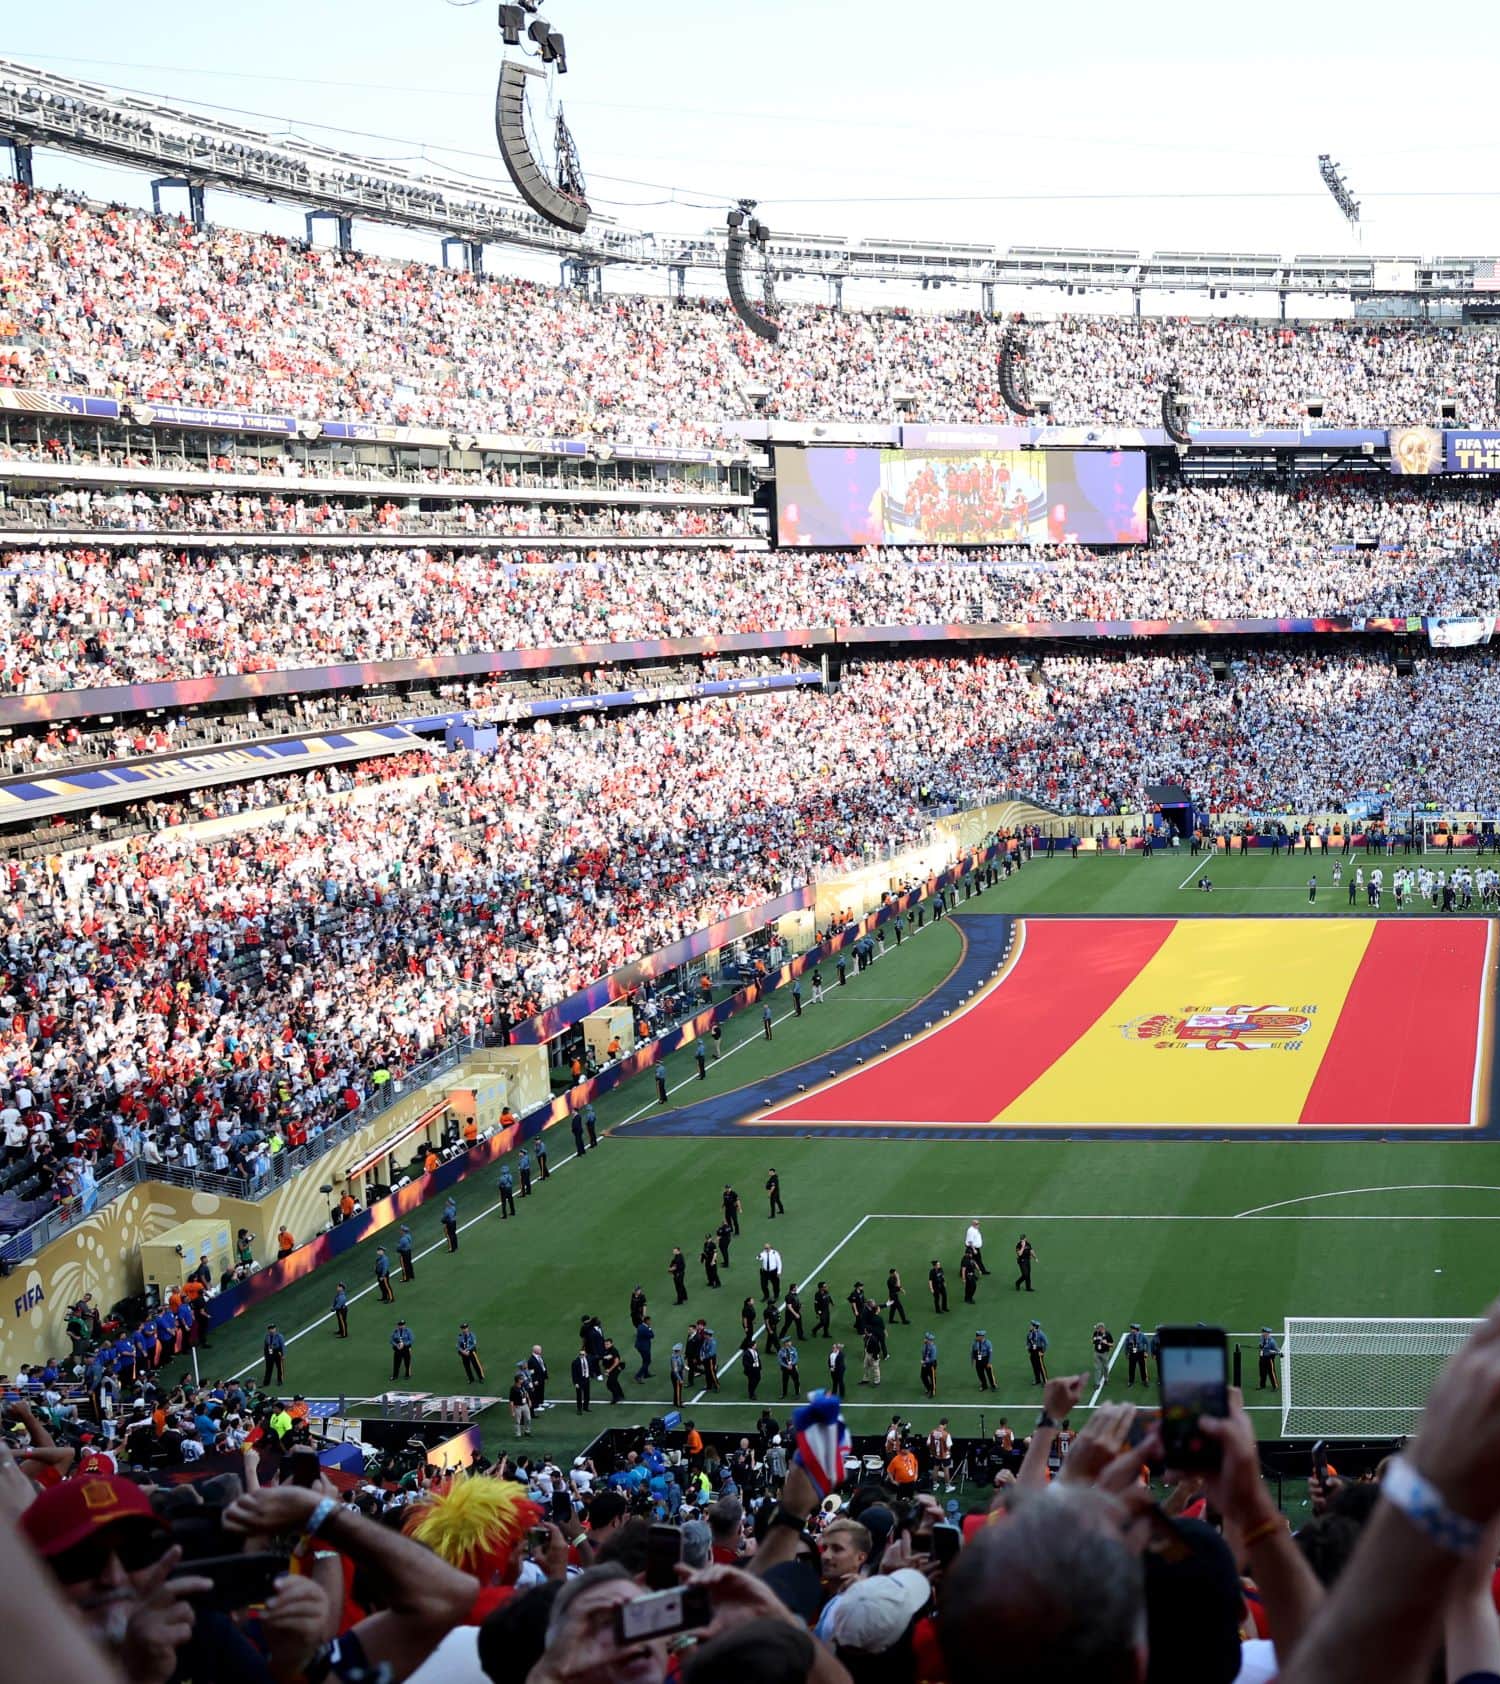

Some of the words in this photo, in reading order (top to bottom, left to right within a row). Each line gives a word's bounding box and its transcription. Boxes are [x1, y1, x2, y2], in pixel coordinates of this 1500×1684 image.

[1455, 438, 1481, 450] FIFA
[128, 761, 191, 779] THE
[186, 750, 266, 771] FINAL
[15, 1284, 45, 1318] FIFA
